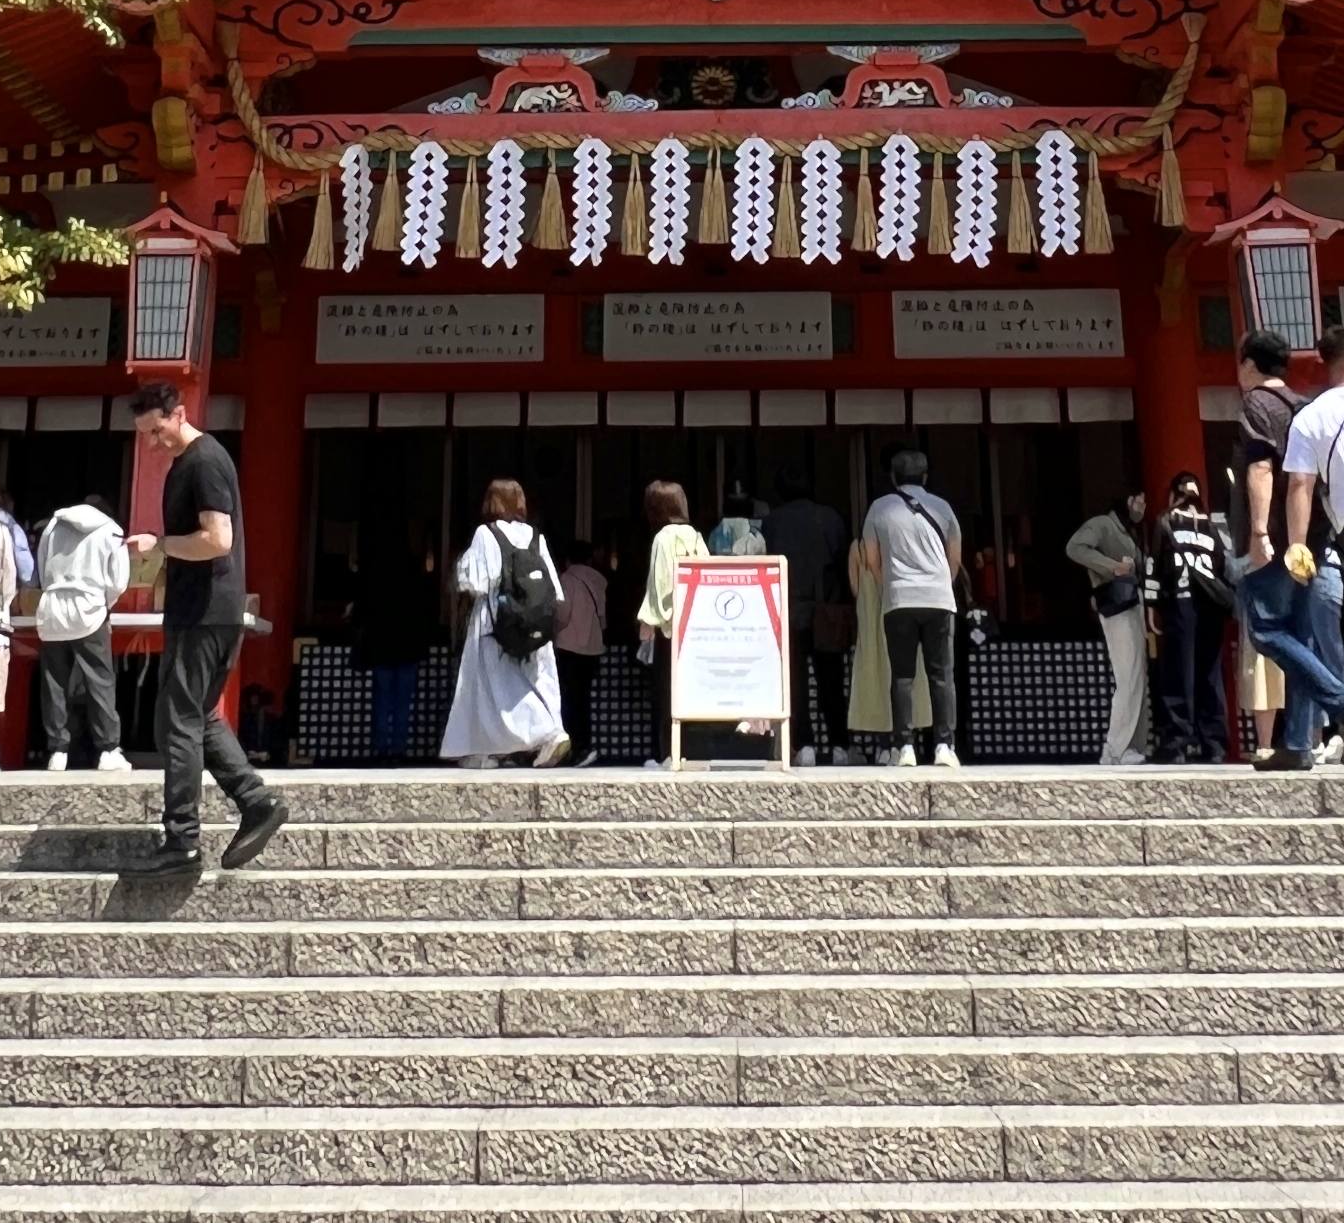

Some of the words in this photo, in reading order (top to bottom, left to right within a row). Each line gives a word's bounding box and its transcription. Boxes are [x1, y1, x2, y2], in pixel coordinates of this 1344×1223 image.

[424, 323, 535, 337] はずしております
[711, 321, 822, 335] はずしております
[1001, 317, 1114, 332] はずしております
